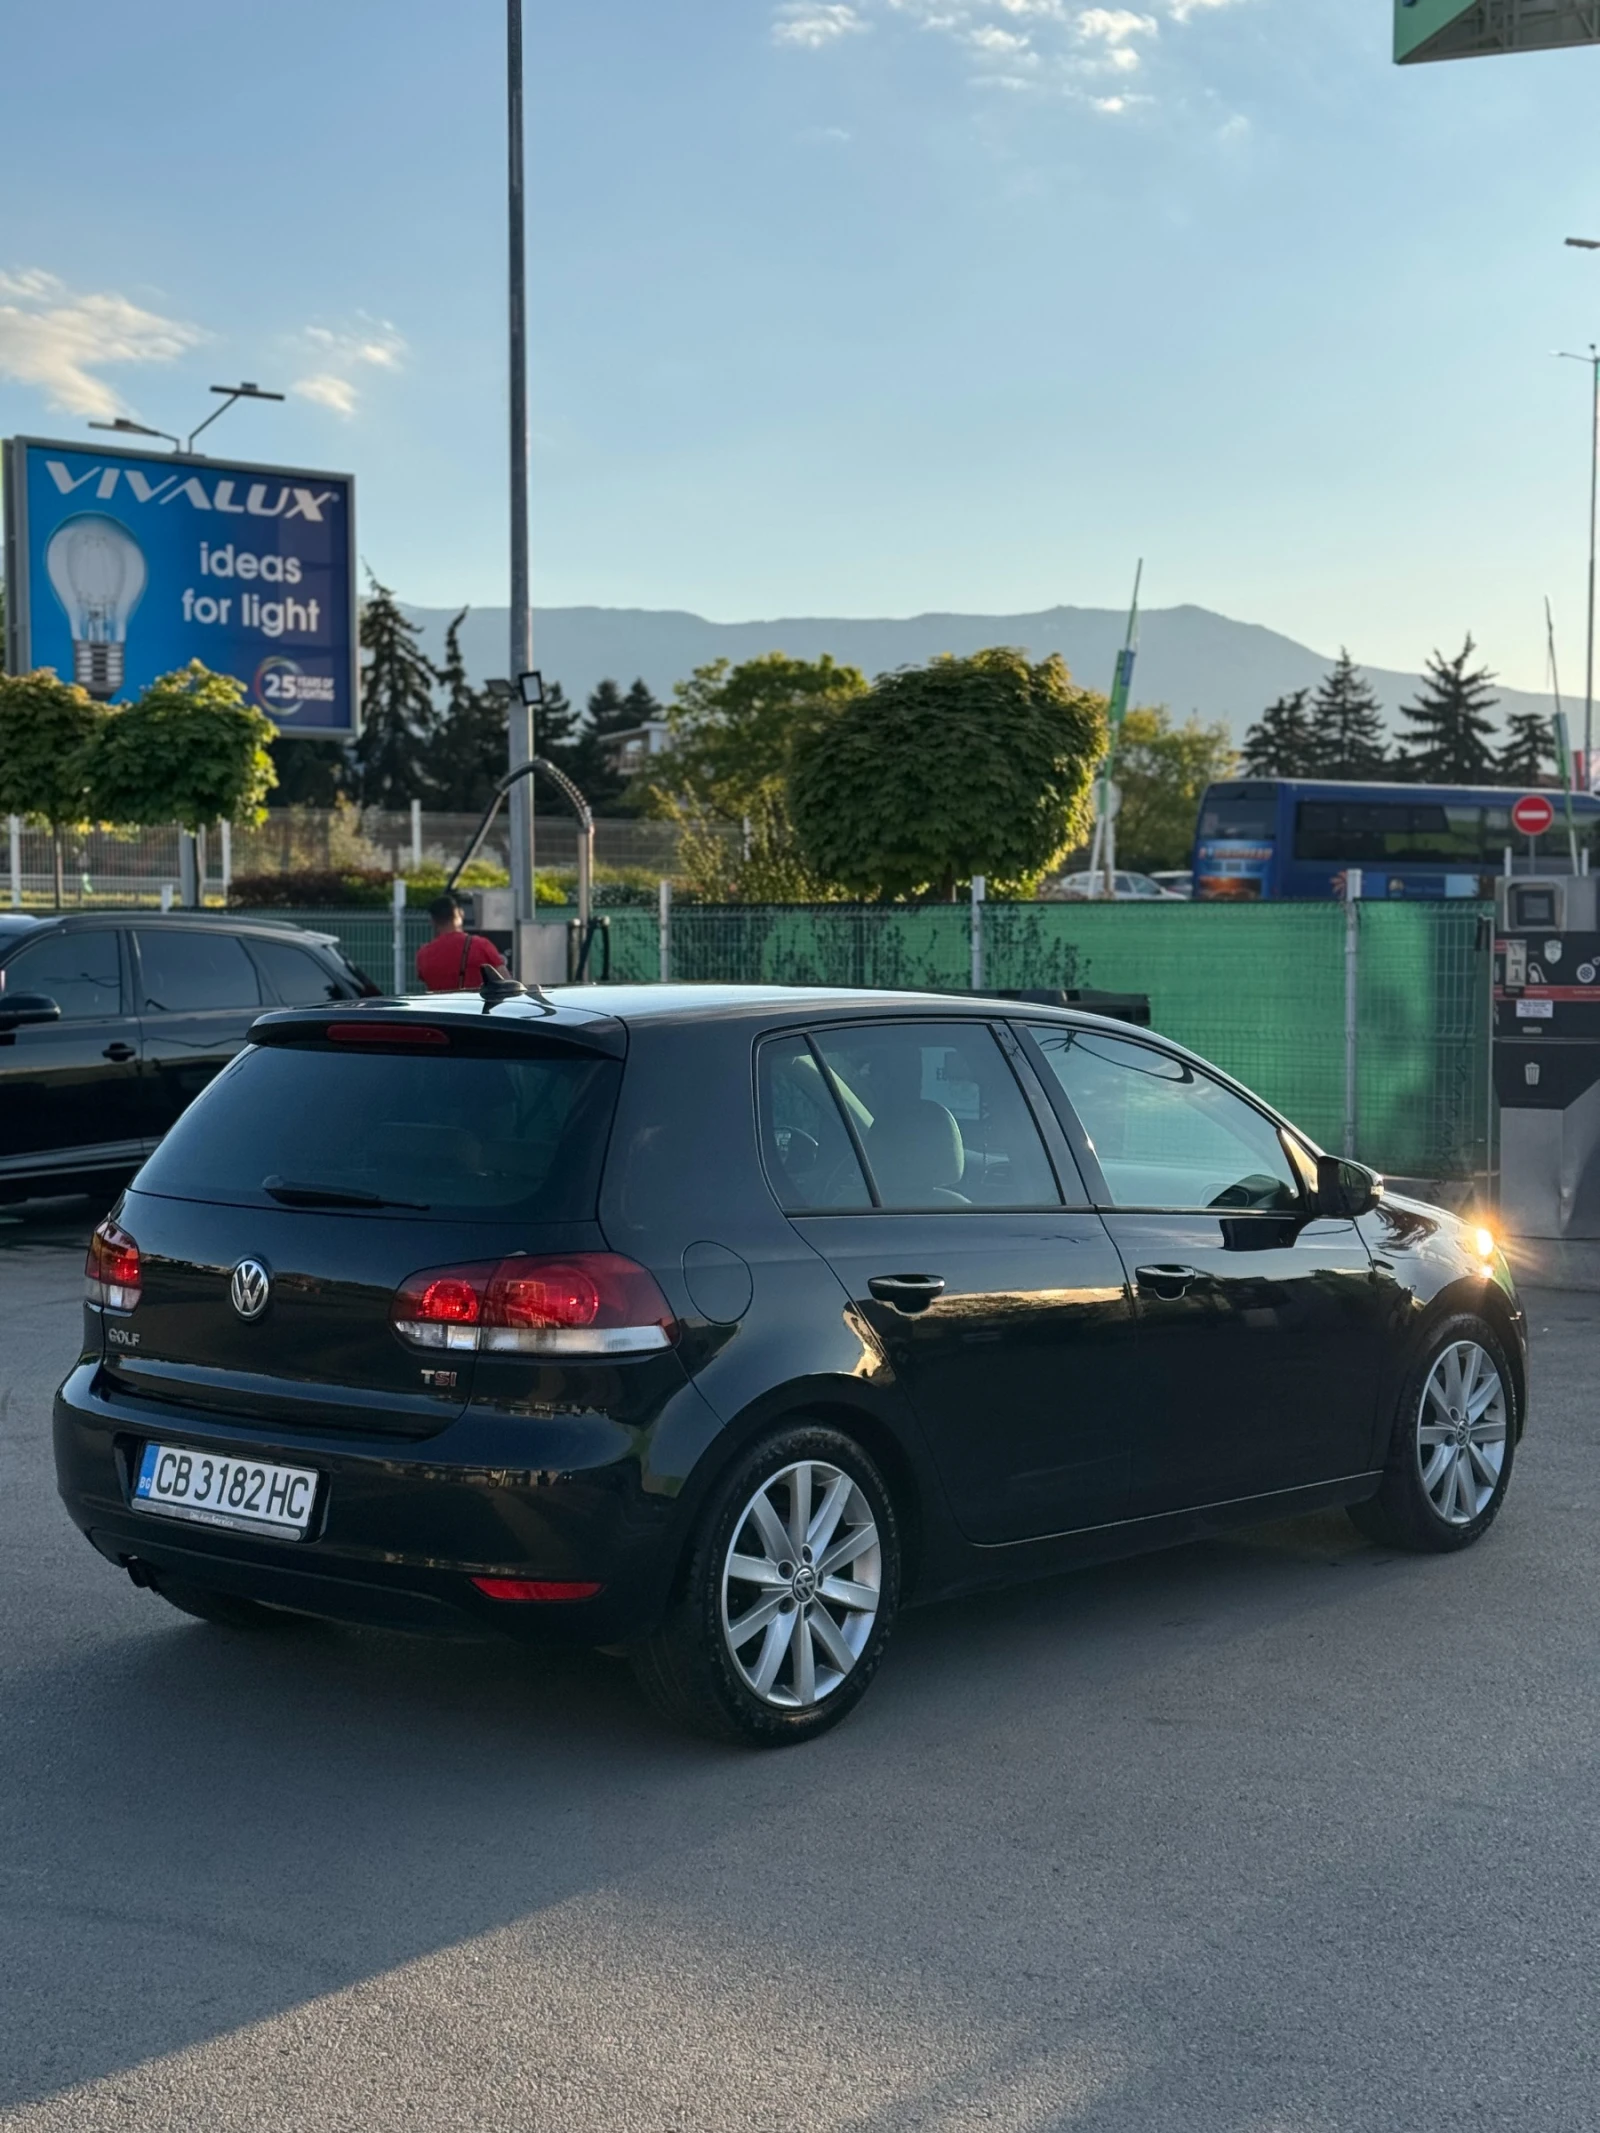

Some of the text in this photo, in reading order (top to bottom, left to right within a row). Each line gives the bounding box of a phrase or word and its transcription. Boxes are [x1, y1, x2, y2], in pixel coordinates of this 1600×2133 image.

[45, 460, 331, 522] VIVALUX
[200, 541, 302, 584] ideas
[181, 588, 320, 638] for light
[264, 673, 296, 699] 25
[108, 1328, 140, 1346] GOLF
[420, 1369, 458, 1387] TSI
[139, 1476, 151, 1489] BG
